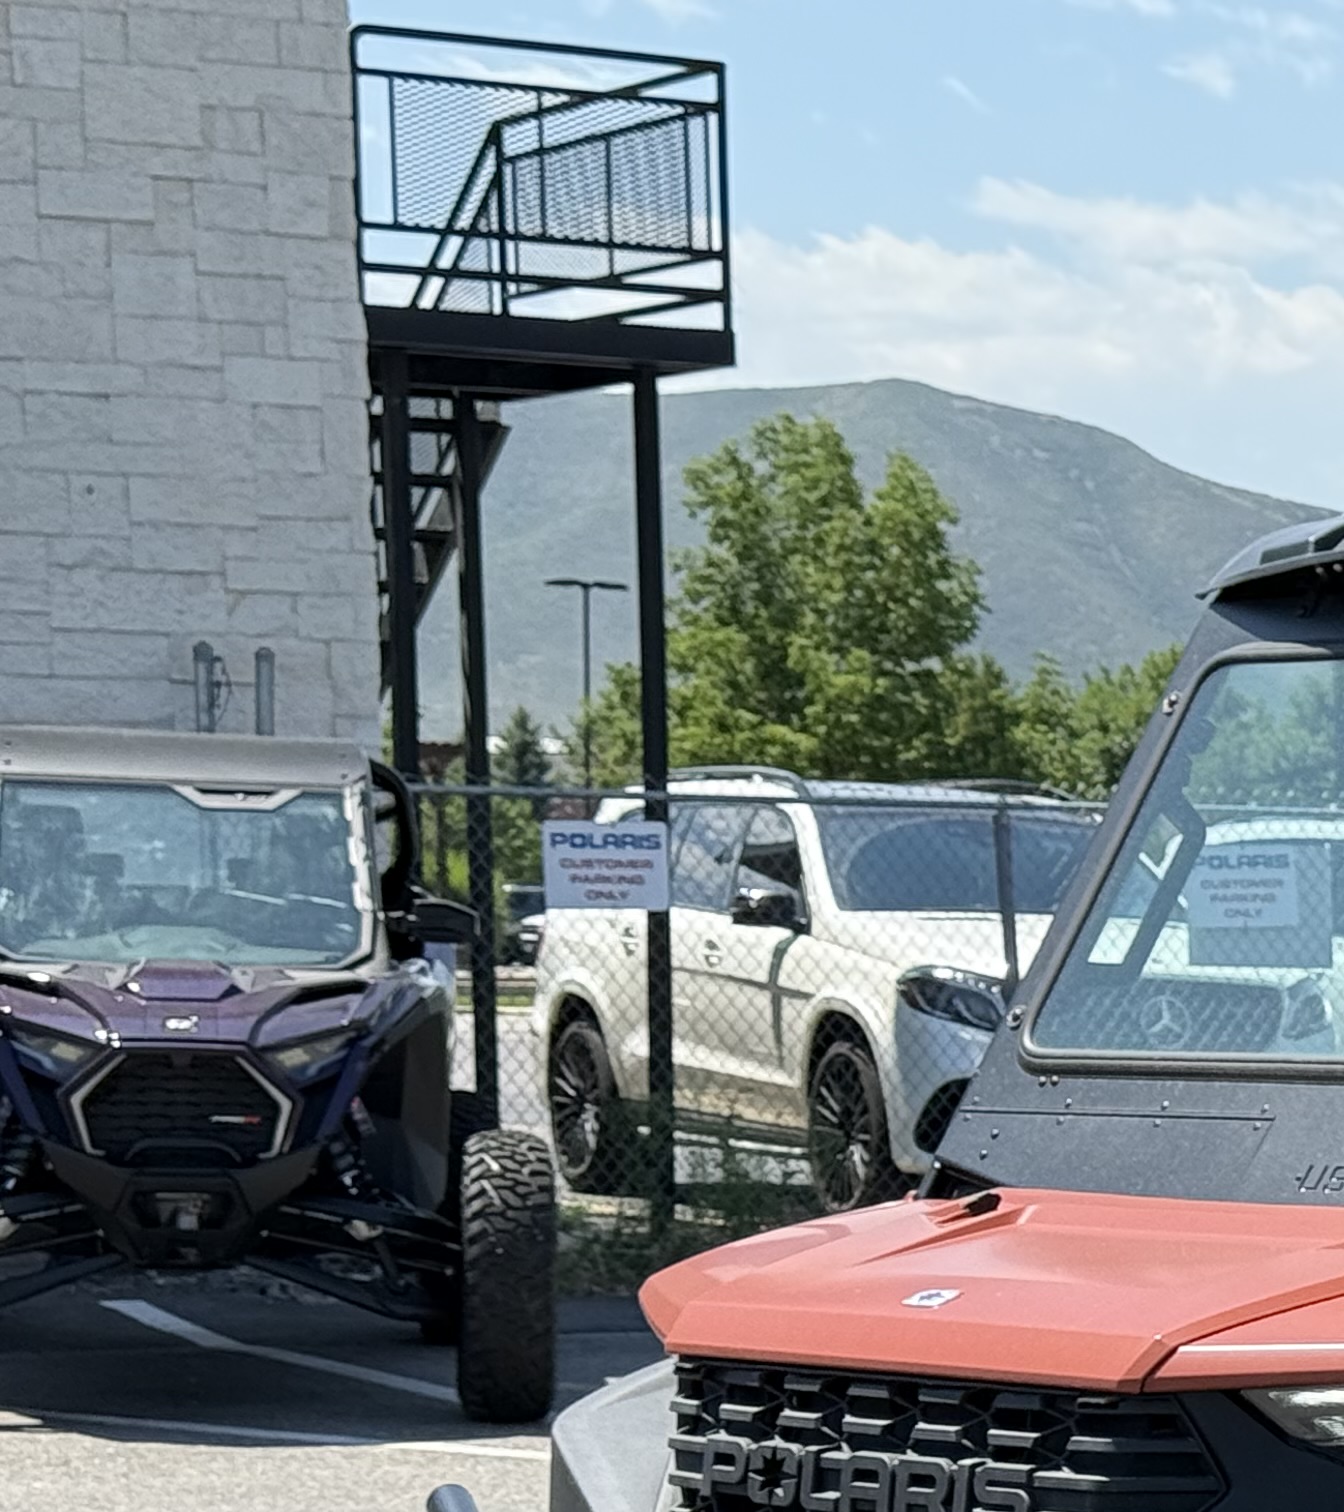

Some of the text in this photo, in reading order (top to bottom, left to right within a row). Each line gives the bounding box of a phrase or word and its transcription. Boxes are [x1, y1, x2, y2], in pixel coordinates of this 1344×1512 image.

[550, 832, 662, 850] POLARIS
[559, 857, 654, 869] CUSTOMER
[568, 872, 646, 885] PARKING
